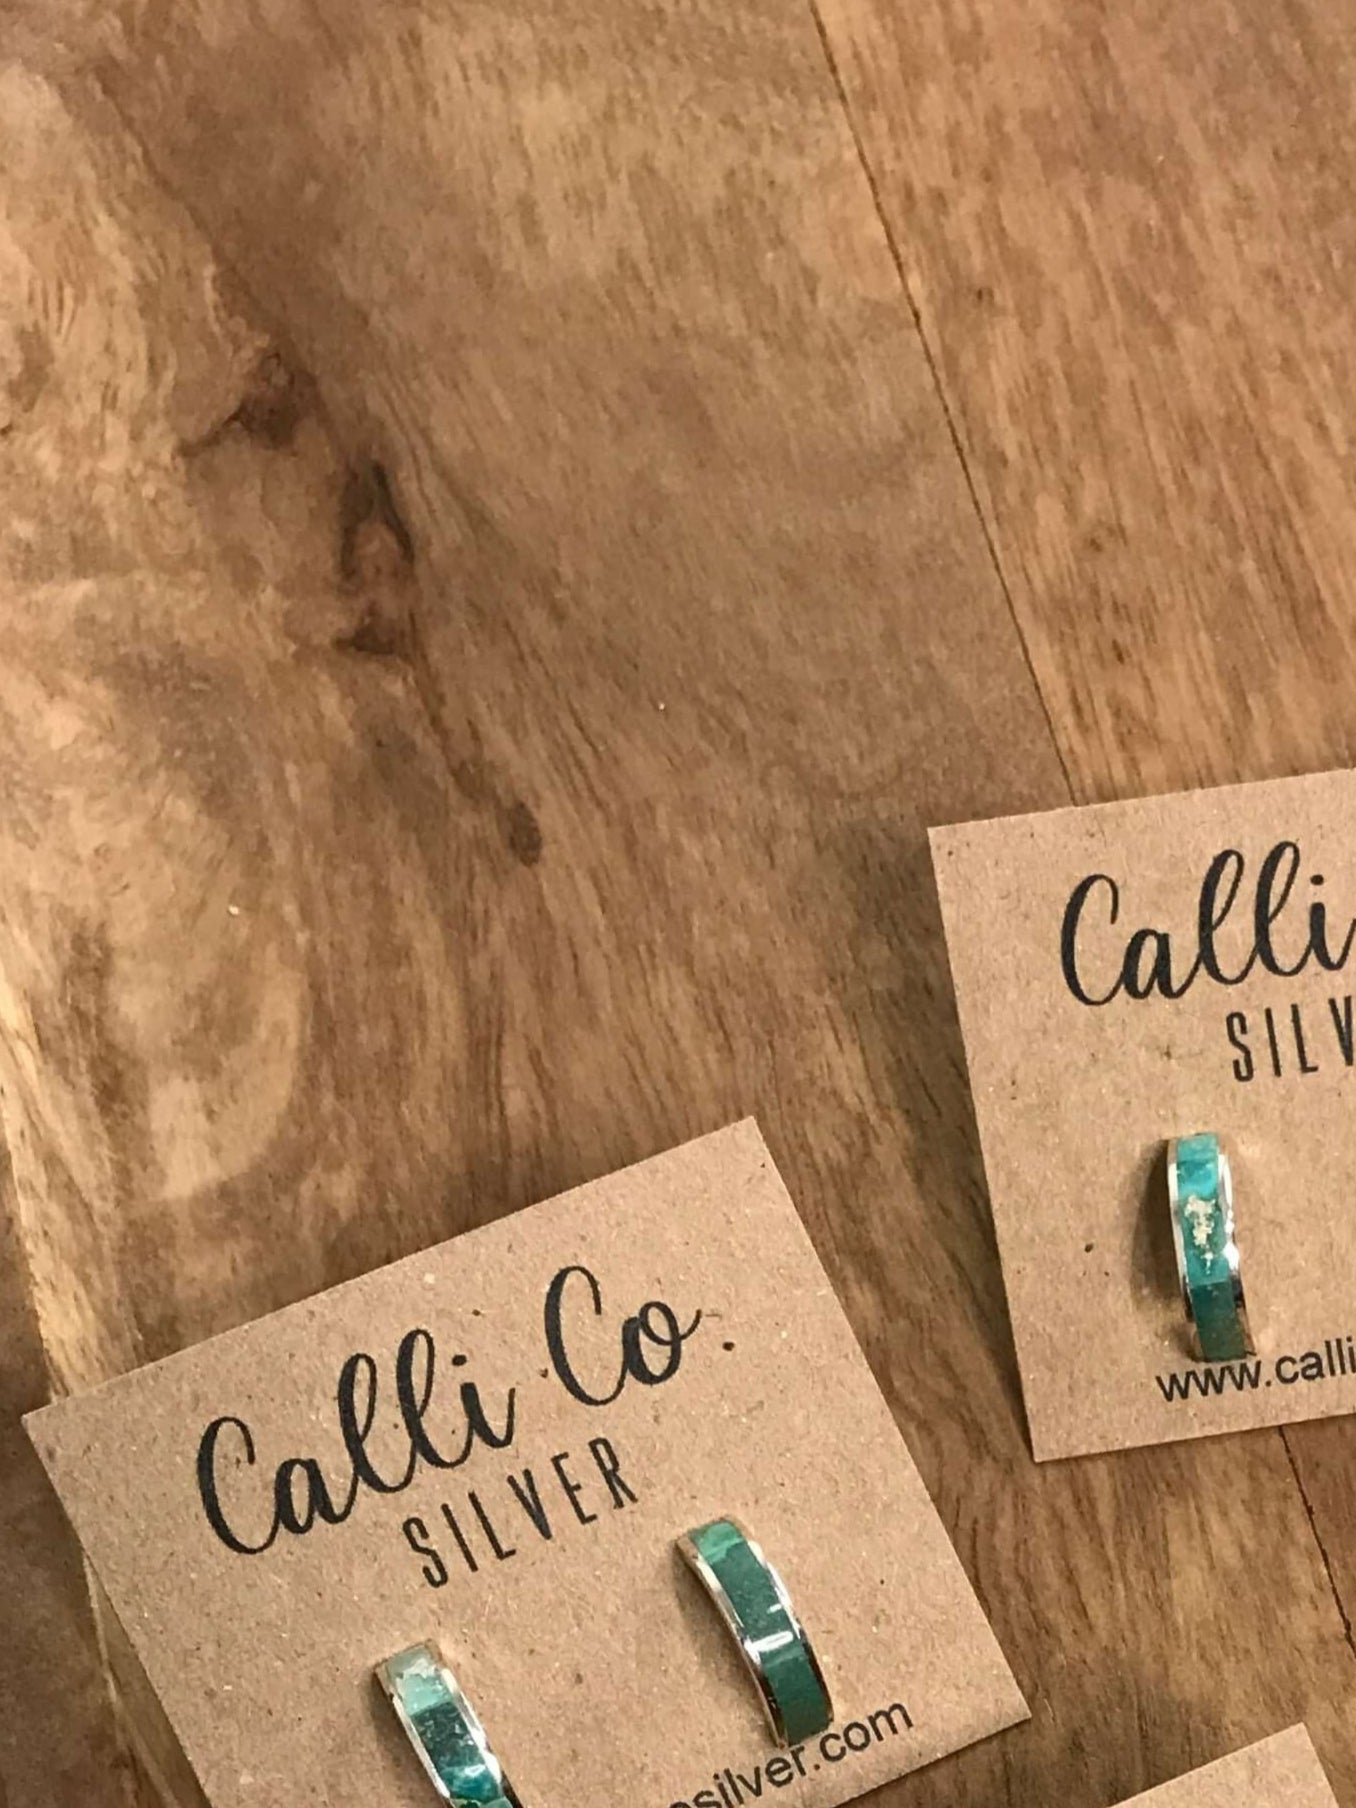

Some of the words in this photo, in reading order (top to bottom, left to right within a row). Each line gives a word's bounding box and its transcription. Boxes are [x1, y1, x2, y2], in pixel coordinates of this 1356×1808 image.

[196, 1328, 516, 1556] Calli
[542, 1265, 735, 1406] Co.
[402, 1437, 638, 1589] SILVER
